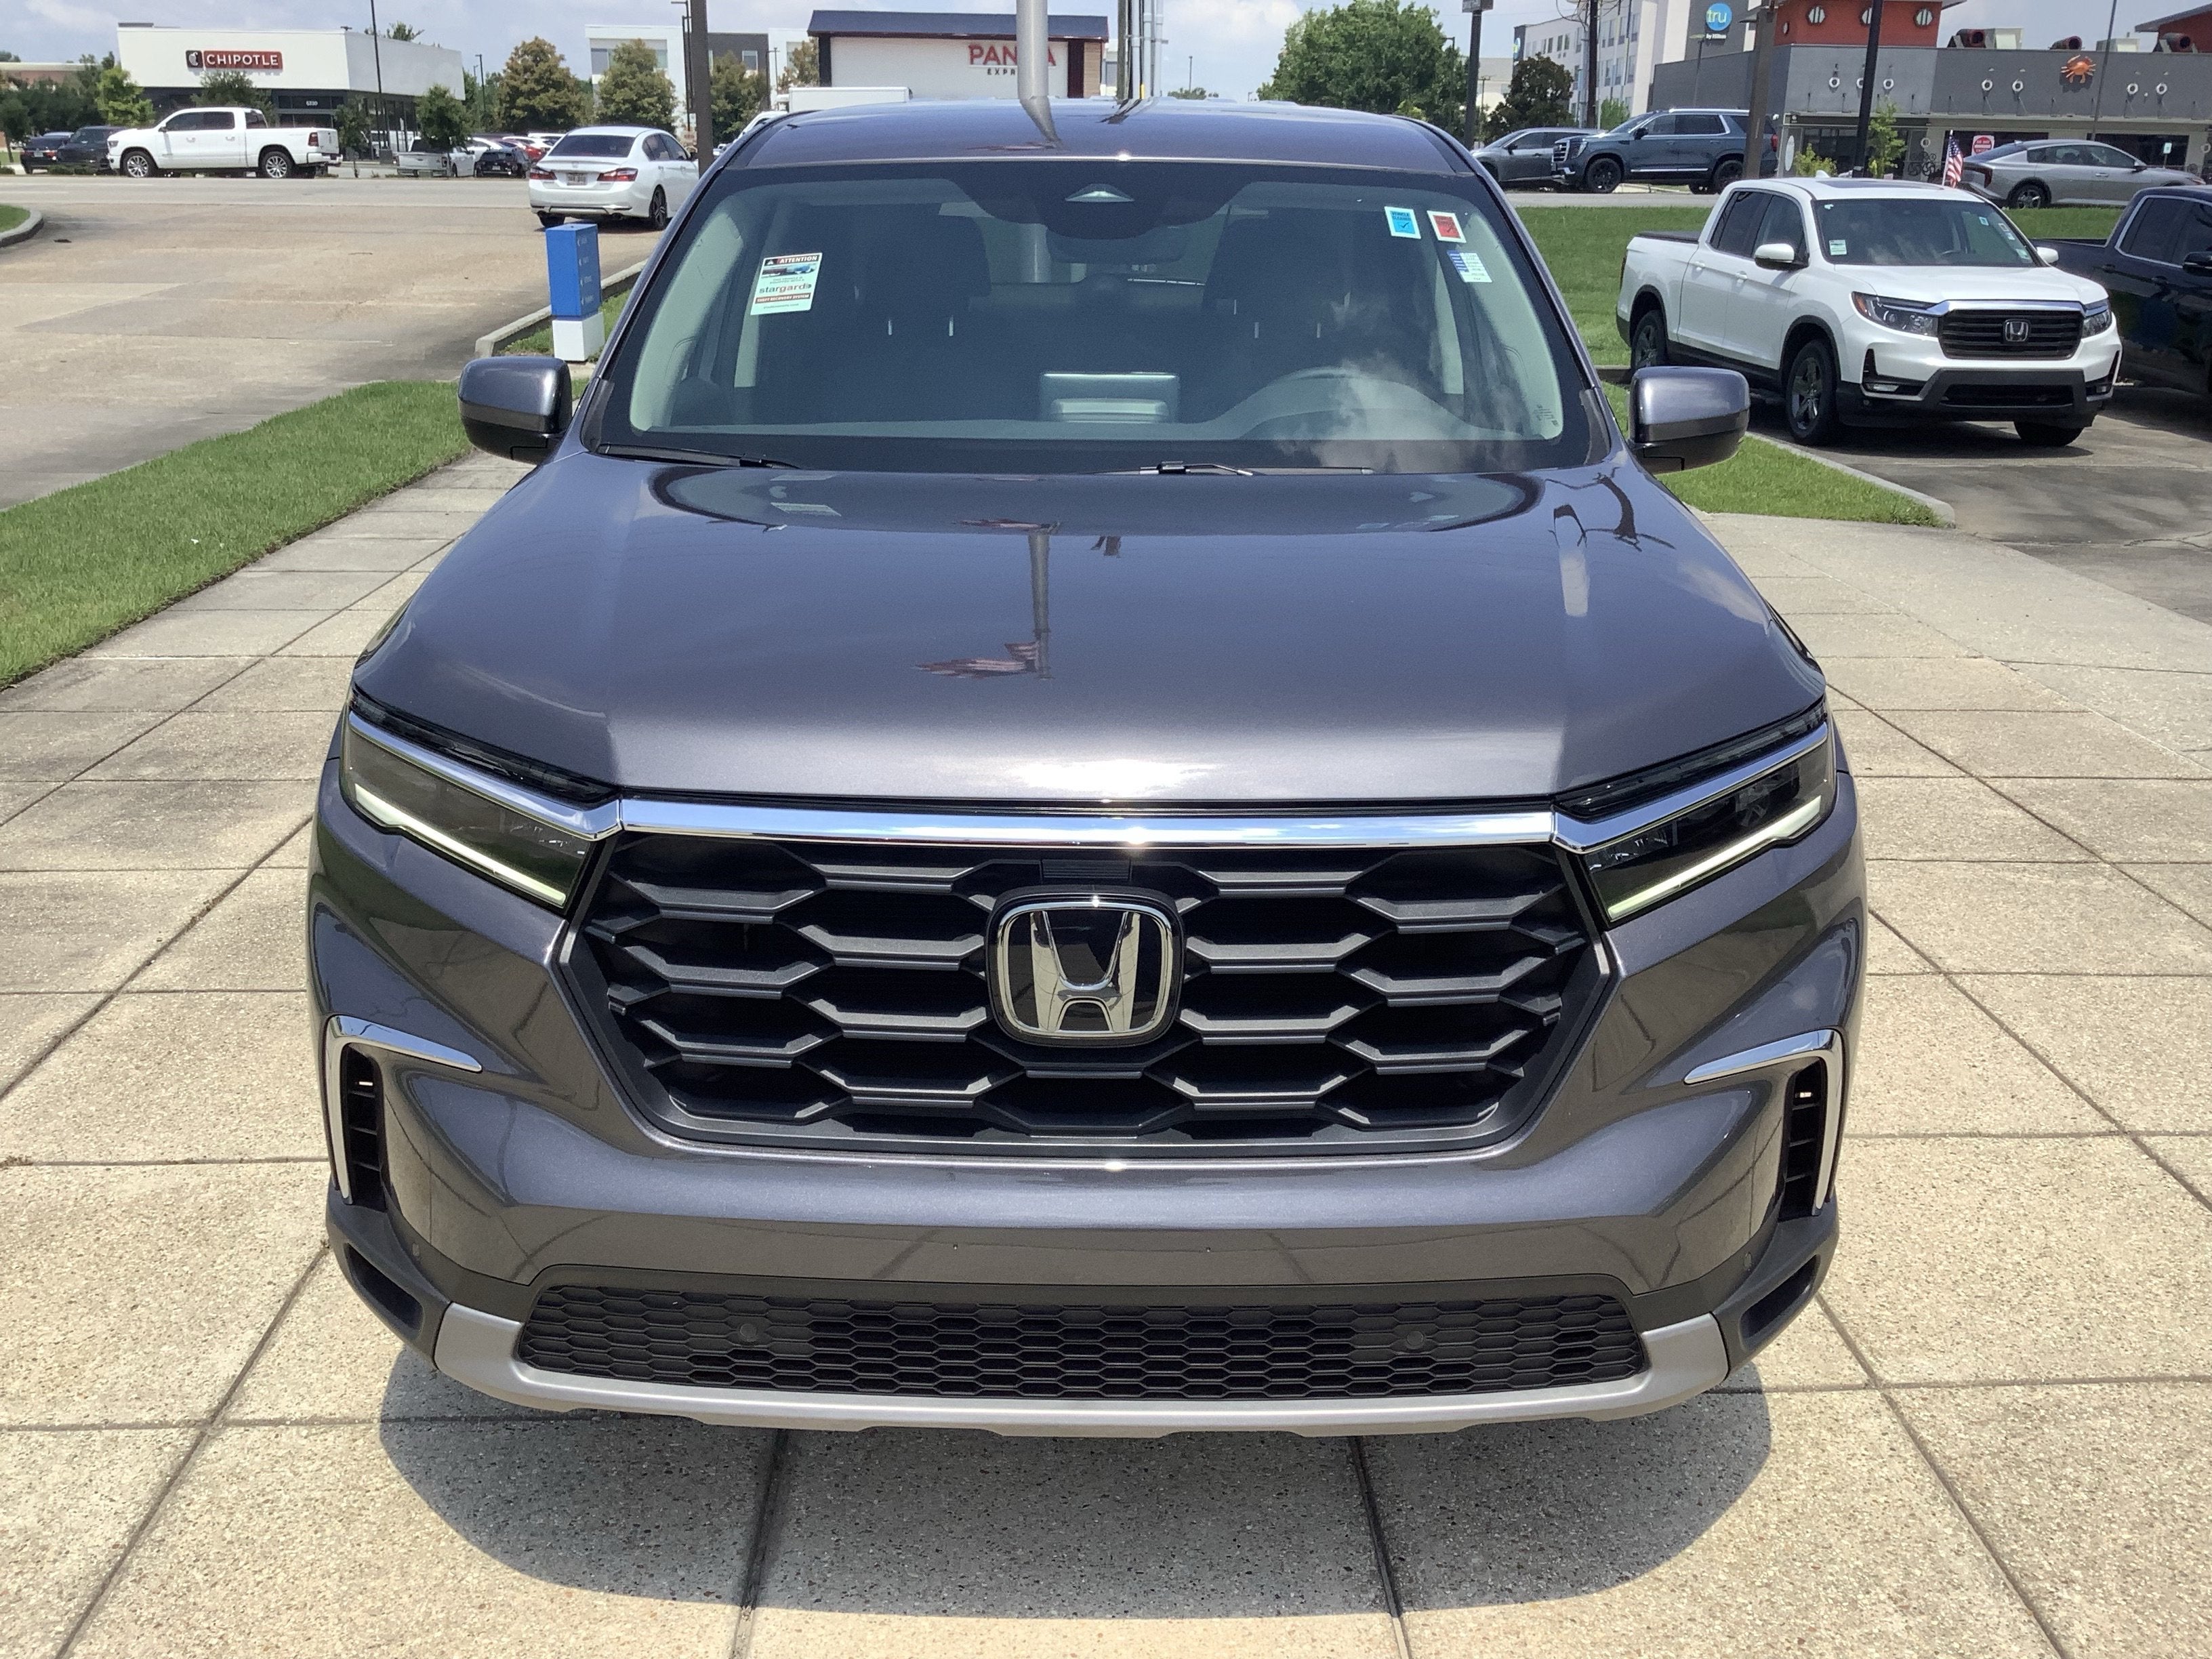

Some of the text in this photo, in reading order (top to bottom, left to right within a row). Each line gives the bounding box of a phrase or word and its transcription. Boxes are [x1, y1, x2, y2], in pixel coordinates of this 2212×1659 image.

[1706, 9, 1727, 23] tru
[206, 54, 279, 66] CHIPOTLE
[968, 43, 1057, 66] PAN
[779, 255, 818, 264] ATTENTION
